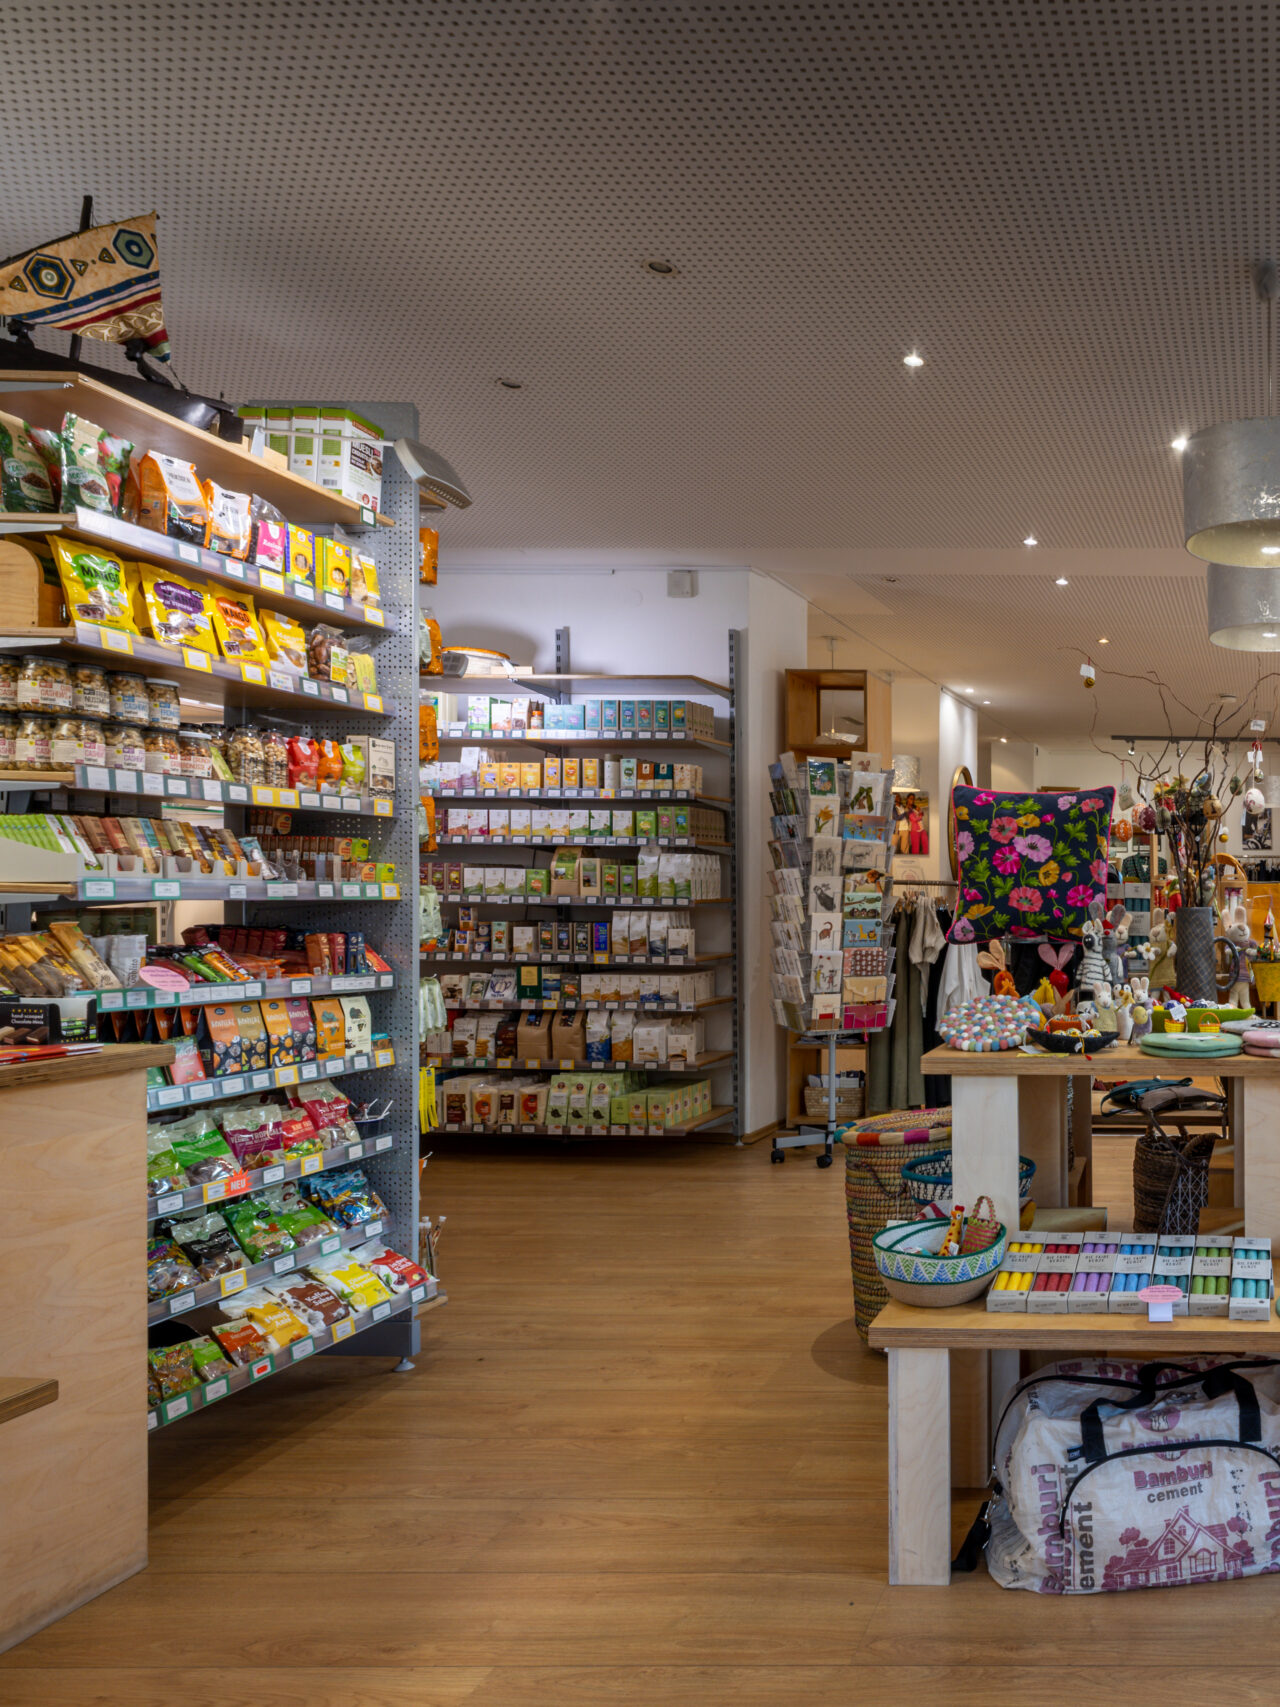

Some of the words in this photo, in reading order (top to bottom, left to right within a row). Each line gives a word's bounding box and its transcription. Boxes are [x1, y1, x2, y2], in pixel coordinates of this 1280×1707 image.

[230, 1179, 247, 1192] NEU
[1133, 1460, 1213, 1490] Bamburi
[1147, 1482, 1204, 1503] cement
[1031, 1463, 1065, 1594] Bamburi
